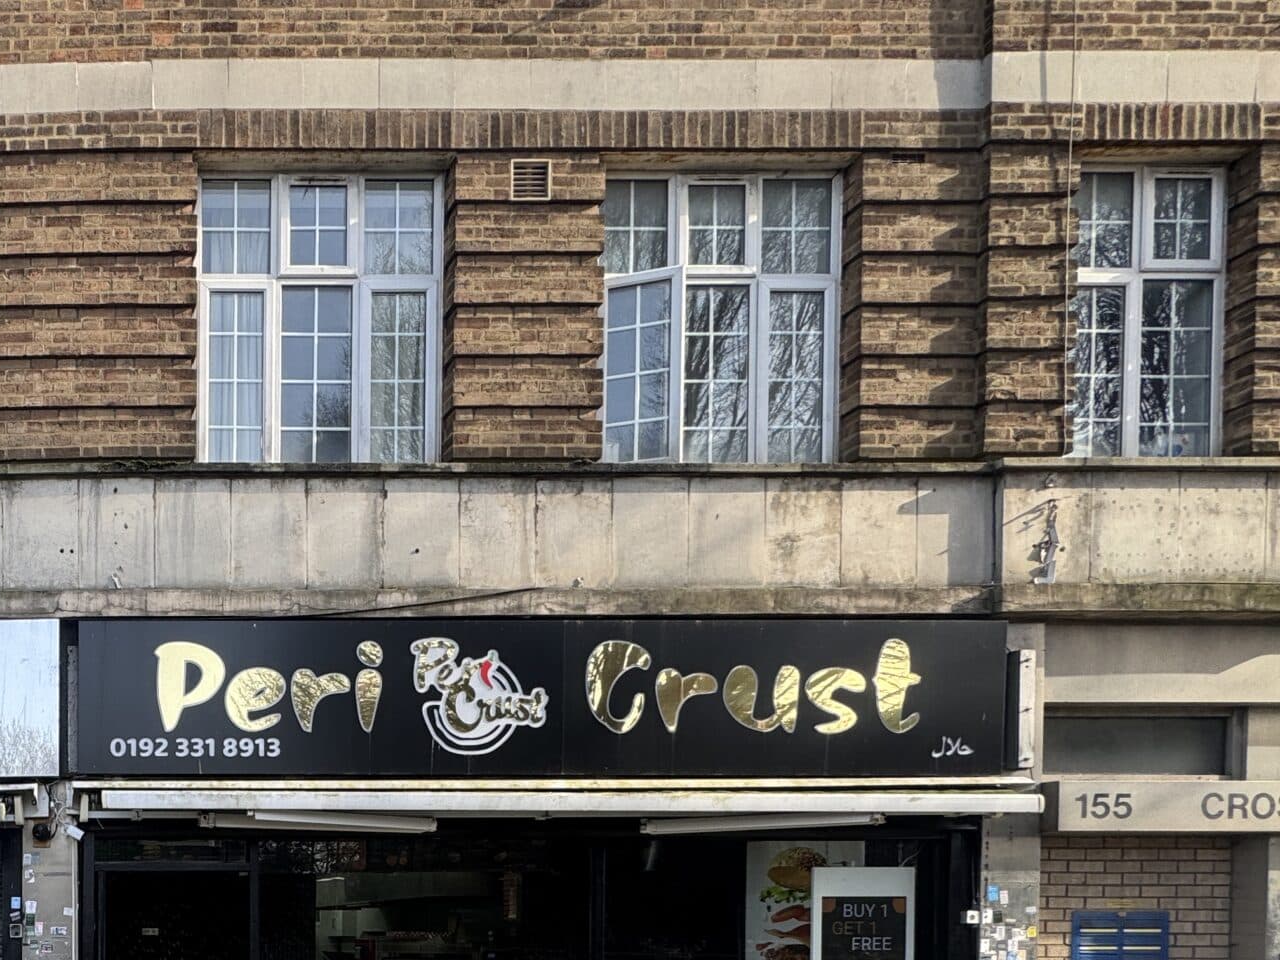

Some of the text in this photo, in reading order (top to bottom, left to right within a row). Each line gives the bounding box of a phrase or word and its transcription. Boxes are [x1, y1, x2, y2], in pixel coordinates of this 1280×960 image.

[154, 640, 384, 733] Peri
[585, 637, 922, 735] Crust
[445, 682, 549, 734] Crust
[110, 737, 282, 758] 0192 331 8913
[931, 736, 975, 758] حلال
[1075, 792, 1133, 820] 155
[842, 903, 888, 918] BUY 1
[832, 920, 877, 935] GET 1
[851, 936, 892, 951] FREE
